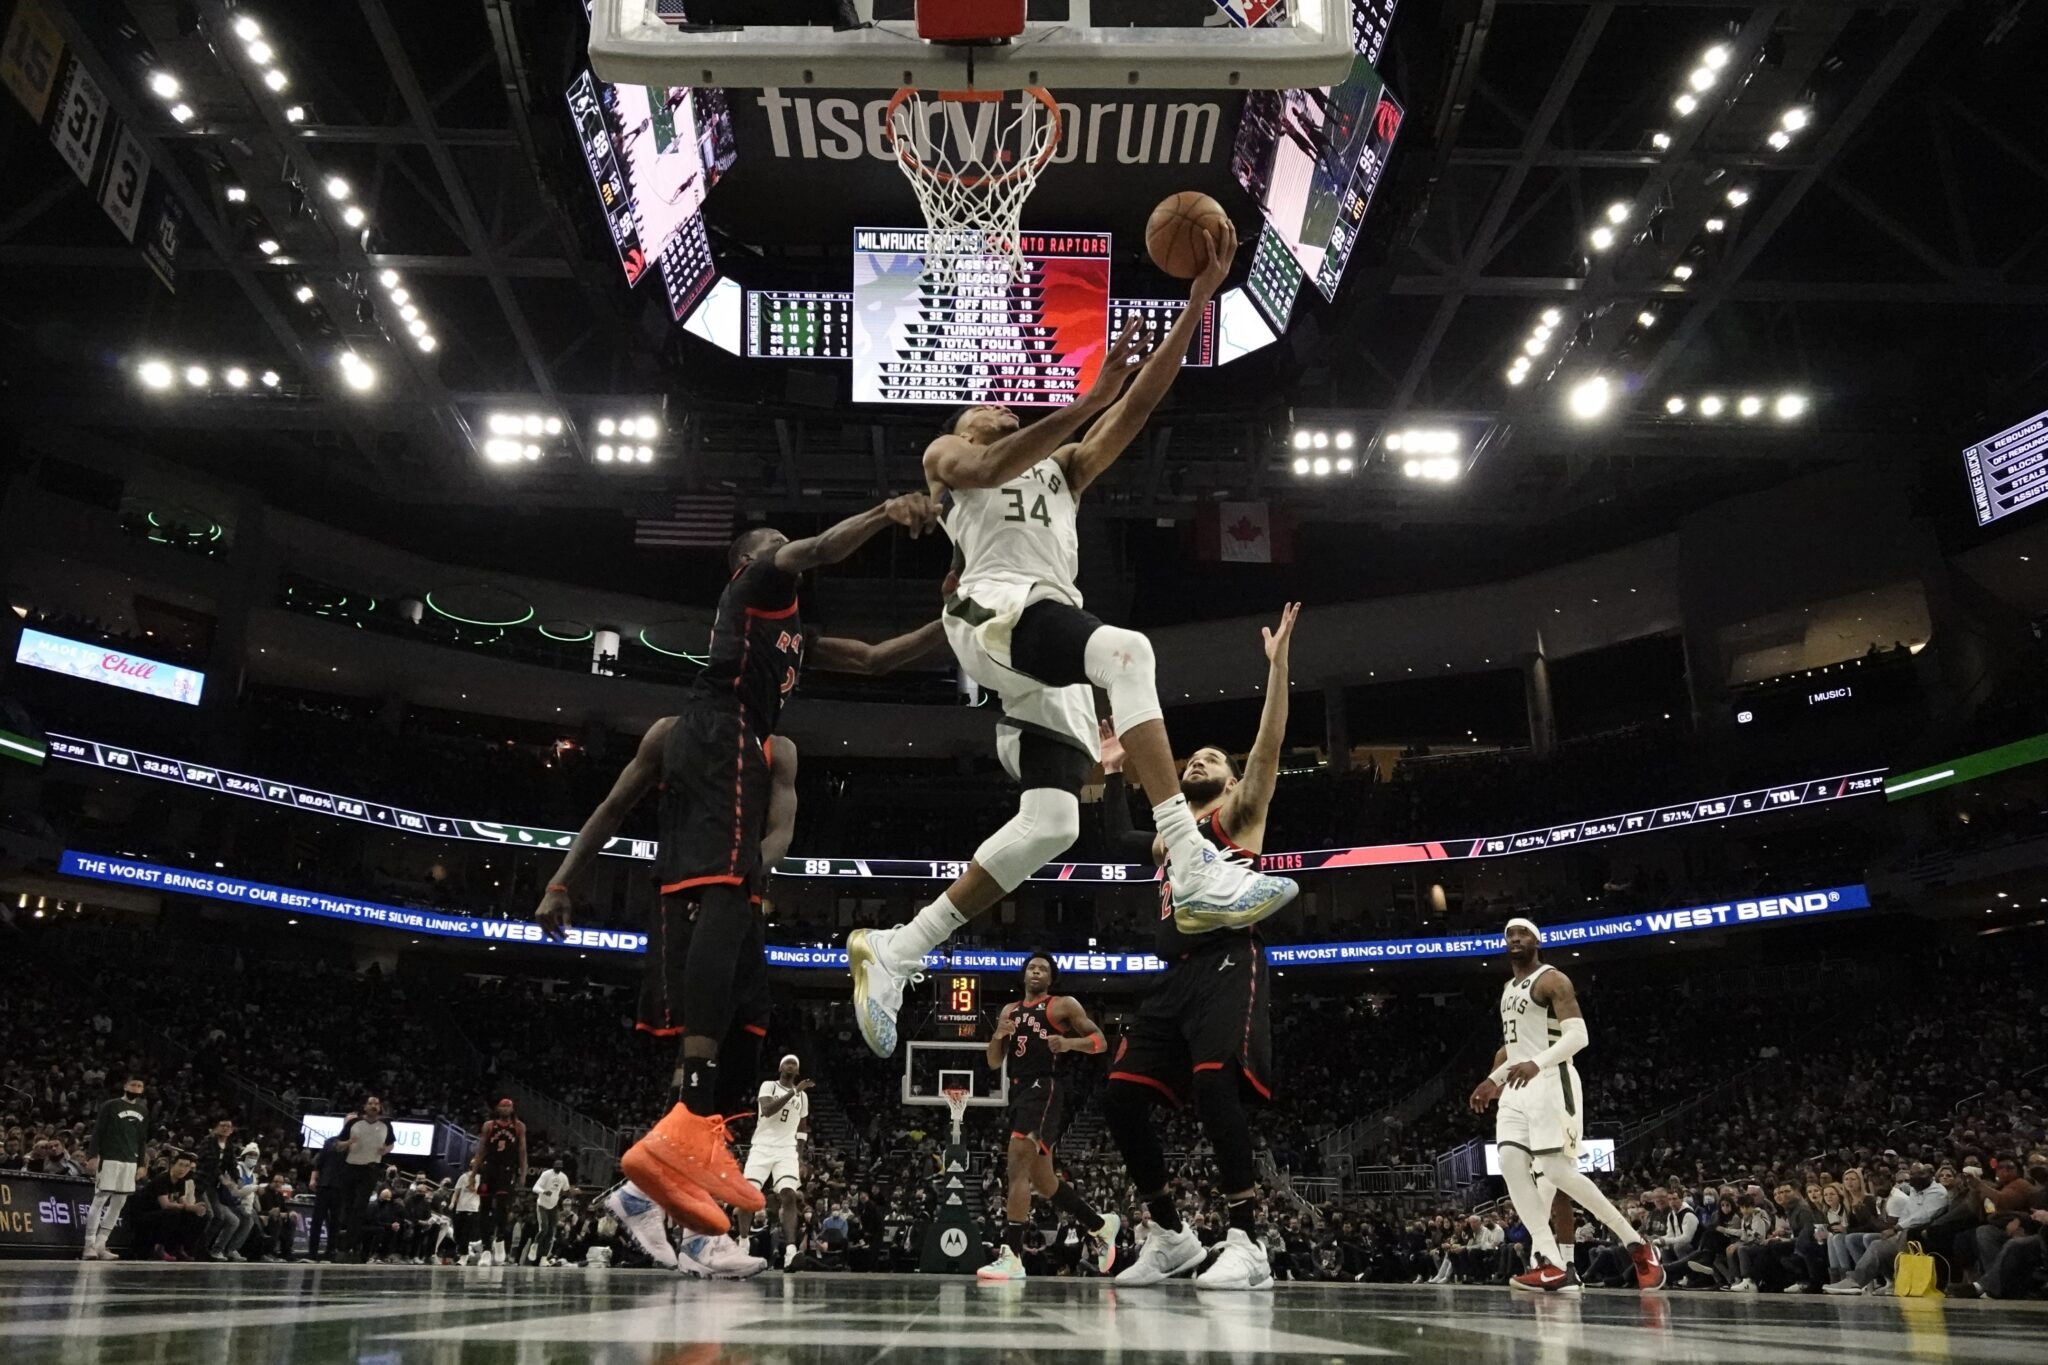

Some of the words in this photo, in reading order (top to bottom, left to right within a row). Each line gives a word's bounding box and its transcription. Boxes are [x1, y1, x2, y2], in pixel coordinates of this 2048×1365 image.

[68, 93, 97, 156] 31
[594, 130, 609, 158] 89
[1360, 145, 1376, 174] 95
[117, 160, 138, 207] 3
[609, 171, 620, 195] 1:31
[602, 182, 614, 206] 4TH
[1345, 188, 1356, 212] 1:31
[1352, 197, 1364, 220] 4TH
[620, 212, 634, 237] 95
[1050, 238, 1106, 253] RAPTORS
[1331, 226, 1345, 251] 89
[957, 273, 1007, 284] BLOCKS
[933, 286, 939, 294] 7
[958, 287, 1006, 297] STEALS
[842, 302, 846, 311] 1
[956, 299, 979, 309] OFF
[982, 300, 1007, 310] REB
[790, 313, 798, 321] 11
[806, 313, 815, 322] 11
[955, 313, 979, 322] DEF
[982, 313, 1007, 323] REB
[1114, 308, 1121, 317] 3
[1165, 310, 1172, 318] 4
[770, 324, 783, 332] 22
[807, 324, 814, 333] 4
[842, 325, 846, 334] 1
[917, 325, 928, 333] 12
[943, 326, 1020, 337] TURNOVERS
[1034, 327, 1045, 336] 14
[1146, 321, 1157, 329] 10
[1164, 321, 1171, 330] 2
[807, 336, 814, 345] 4
[826, 336, 830, 345] 1
[842, 337, 846, 345] 1
[916, 338, 927, 346] 17
[939, 338, 978, 349] TOTAL
[982, 339, 1022, 350] FOULS
[1147, 343, 1153, 352] 7
[770, 347, 783, 355] 34
[824, 348, 831, 356] 4
[934, 352, 977, 362] BENCH
[981, 352, 1026, 363] POINTS
[968, 378, 992, 388] 3PT
[972, 391, 988, 400] FT
[1994, 420, 2044, 449] REBOUNDS
[1966, 448, 1982, 478] BUCKS
[1993, 454, 2008, 465] OFF
[2007, 453, 2044, 474] BLOCKS
[2012, 468, 2046, 489] STEALS
[1972, 475, 1992, 522] MILWAUKEE
[1002, 488, 1051, 528] 34
[102, 654, 158, 680] Chill
[1739, 712, 1751, 722] CC
[68, 746, 85, 756] PM
[108, 751, 128, 765] FG
[143, 760, 179, 776] 33.8%
[186, 769, 216, 784] 3PT
[226, 778, 260, 793] 32.4%
[1818, 786, 1827, 796] 2
[1848, 779, 1872, 790] 7:52
[269, 786, 288, 799] FT
[1770, 790, 1800, 804] TOL
[338, 800, 362, 816] FLS
[1699, 802, 1725, 817] FLS
[400, 814, 423, 828] TOL
[1627, 816, 1644, 829] FT
[1662, 810, 1691, 823] 57.1%
[438, 823, 447, 832] 2
[1584, 823, 1616, 836] 32.4%
[1515, 835, 1544, 849] 42.7%
[1552, 828, 1577, 842] 3PT
[1487, 840, 1504, 853] FG
[805, 860, 830, 874] 89
[1260, 855, 1302, 870] PTORS
[1101, 865, 1126, 880] 95
[77, 858, 106, 873] THE
[109, 863, 162, 882] WORST
[164, 873, 214, 891] BRINGS
[217, 883, 246, 897] OUT
[249, 888, 277, 902] OUR
[320, 900, 362, 916] THAT'S
[363, 906, 386, 920] THE
[388, 912, 423, 927] SILVER
[482, 921, 553, 942] WES
[1161, 881, 1172, 920] 2
[1550, 928, 1587, 942] SILVER
[1646, 906, 1731, 931] WEST
[770, 950, 810, 963] BRINGS
[812, 952, 838, 963] OUT
[1272, 950, 1294, 961] THE
[1296, 948, 1337, 960] WORST
[1340, 946, 1384, 958] BRINGS
[1386, 944, 1412, 955] OUT
[1418, 942, 1442, 954] OUR
[963, 955, 998, 967] SILVER
[1052, 955, 1121, 970] WEST
[953, 977, 975, 990] 1:31
[953, 990, 971, 1011] 19
[1014, 1012, 1048, 1039] PTORS
[1503, 1020, 1518, 1044] 23
[1015, 1035, 1028, 1057] 3
[781, 1108, 789, 1122] 9
[397, 1130, 421, 1147] UB
[0, 1211, 33, 1233] NCE
